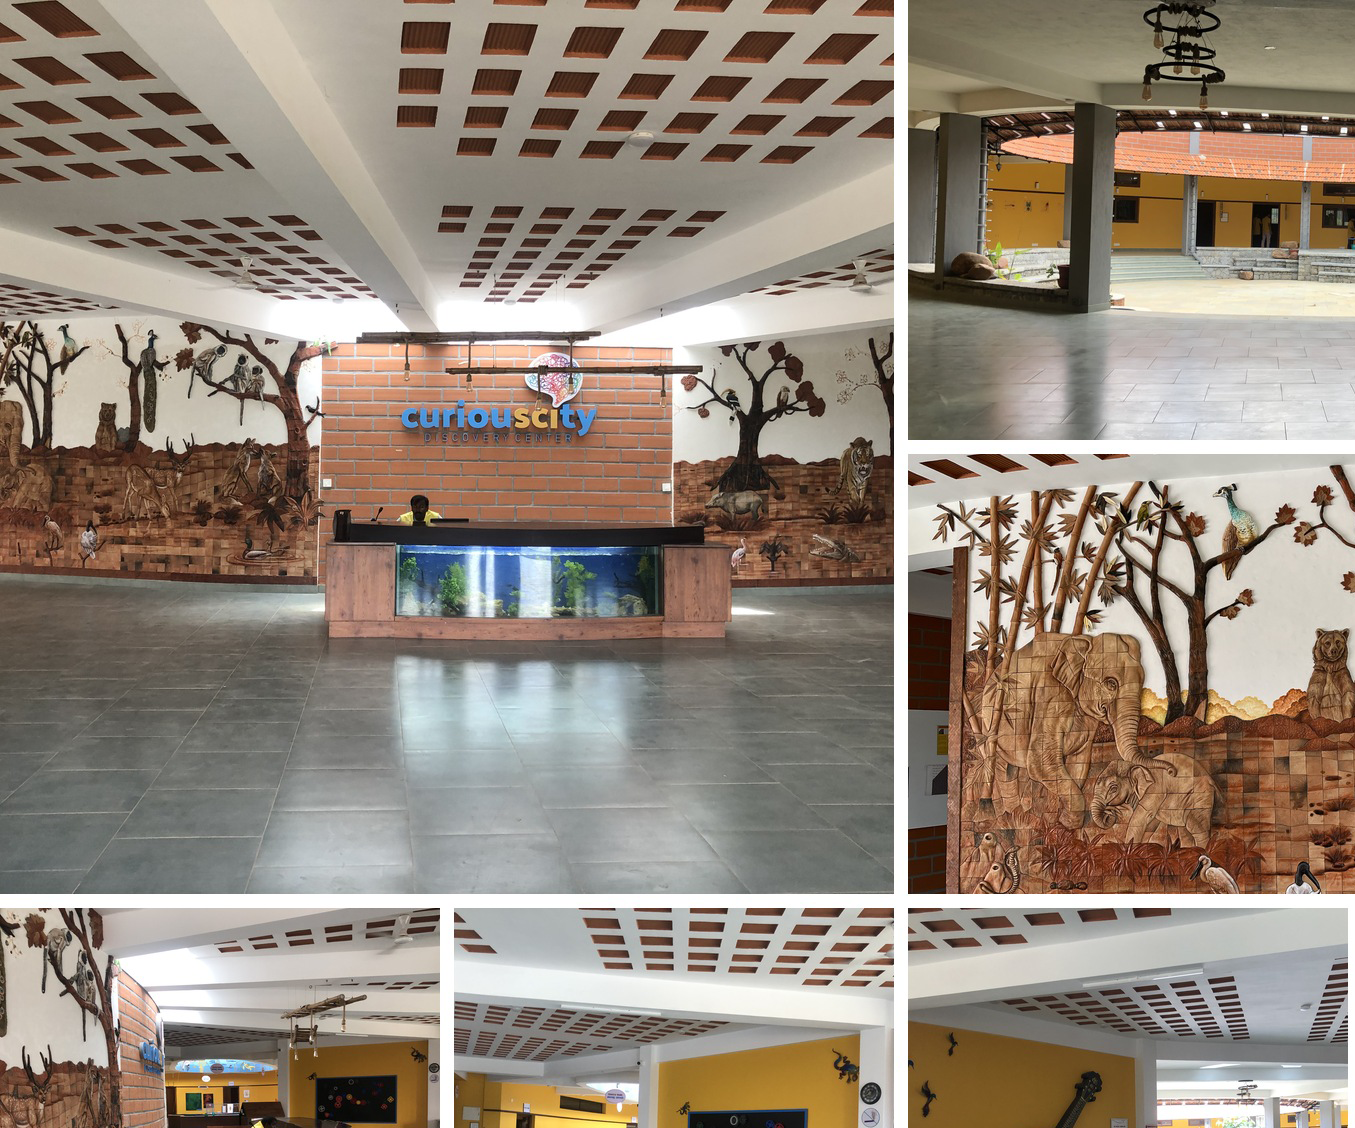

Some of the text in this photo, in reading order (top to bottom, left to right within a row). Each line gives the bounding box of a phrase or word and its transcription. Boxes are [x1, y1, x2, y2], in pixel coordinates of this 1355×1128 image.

[401, 400, 597, 436] curiouscity
[424, 432, 573, 443] DISCOVERY CENTER
